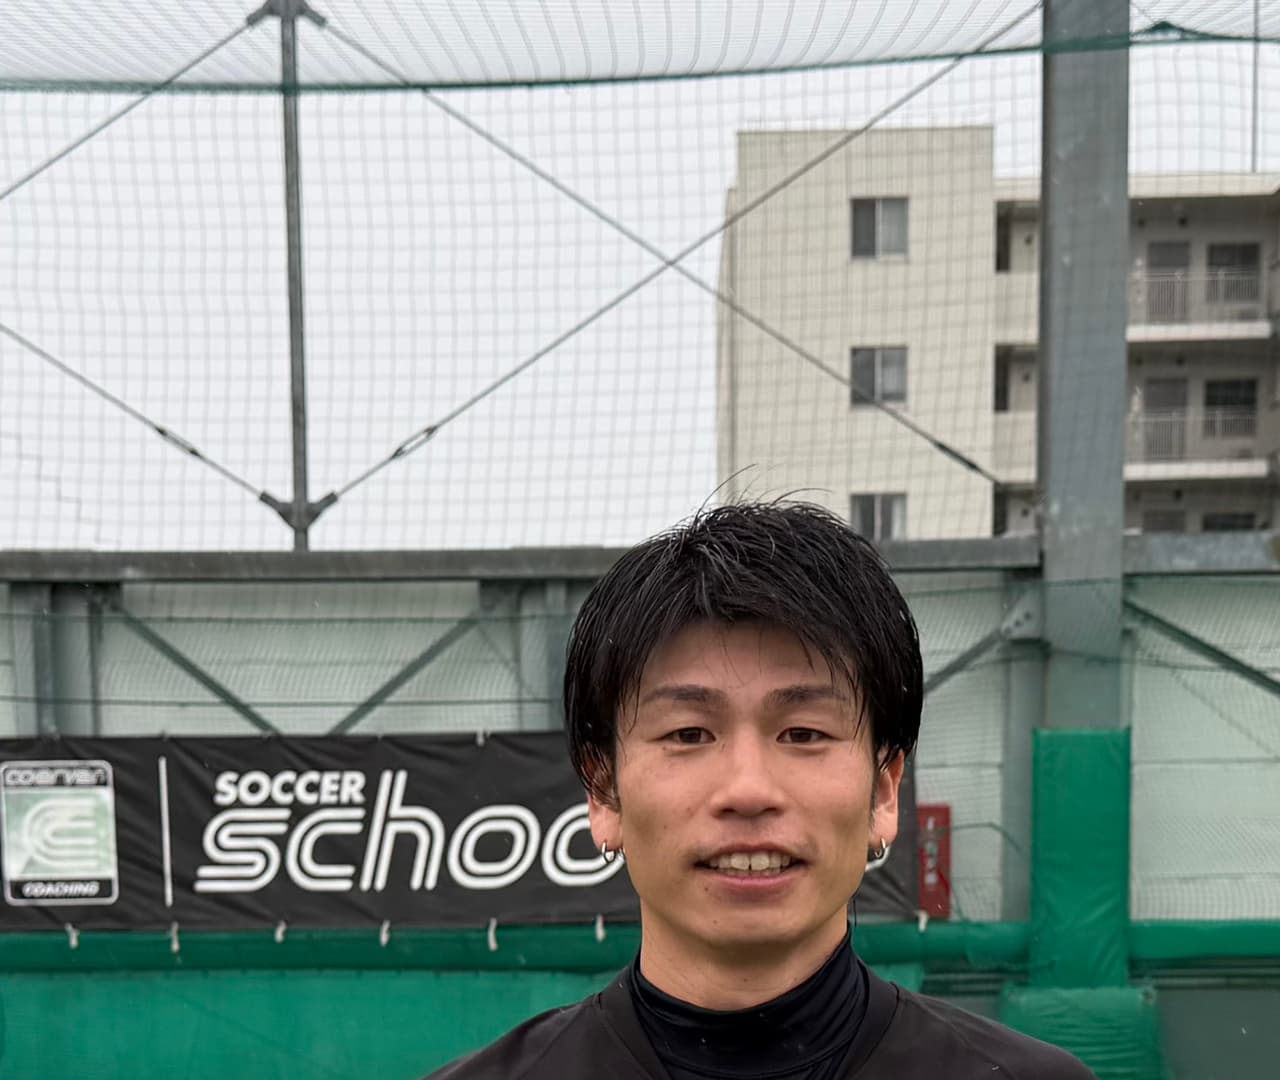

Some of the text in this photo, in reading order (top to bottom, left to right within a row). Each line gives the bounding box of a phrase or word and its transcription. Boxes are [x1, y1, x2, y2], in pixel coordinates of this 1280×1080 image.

[214, 770, 366, 805] SOCCER
[194, 770, 625, 892] schoo
[22, 881, 100, 897] COACHING
